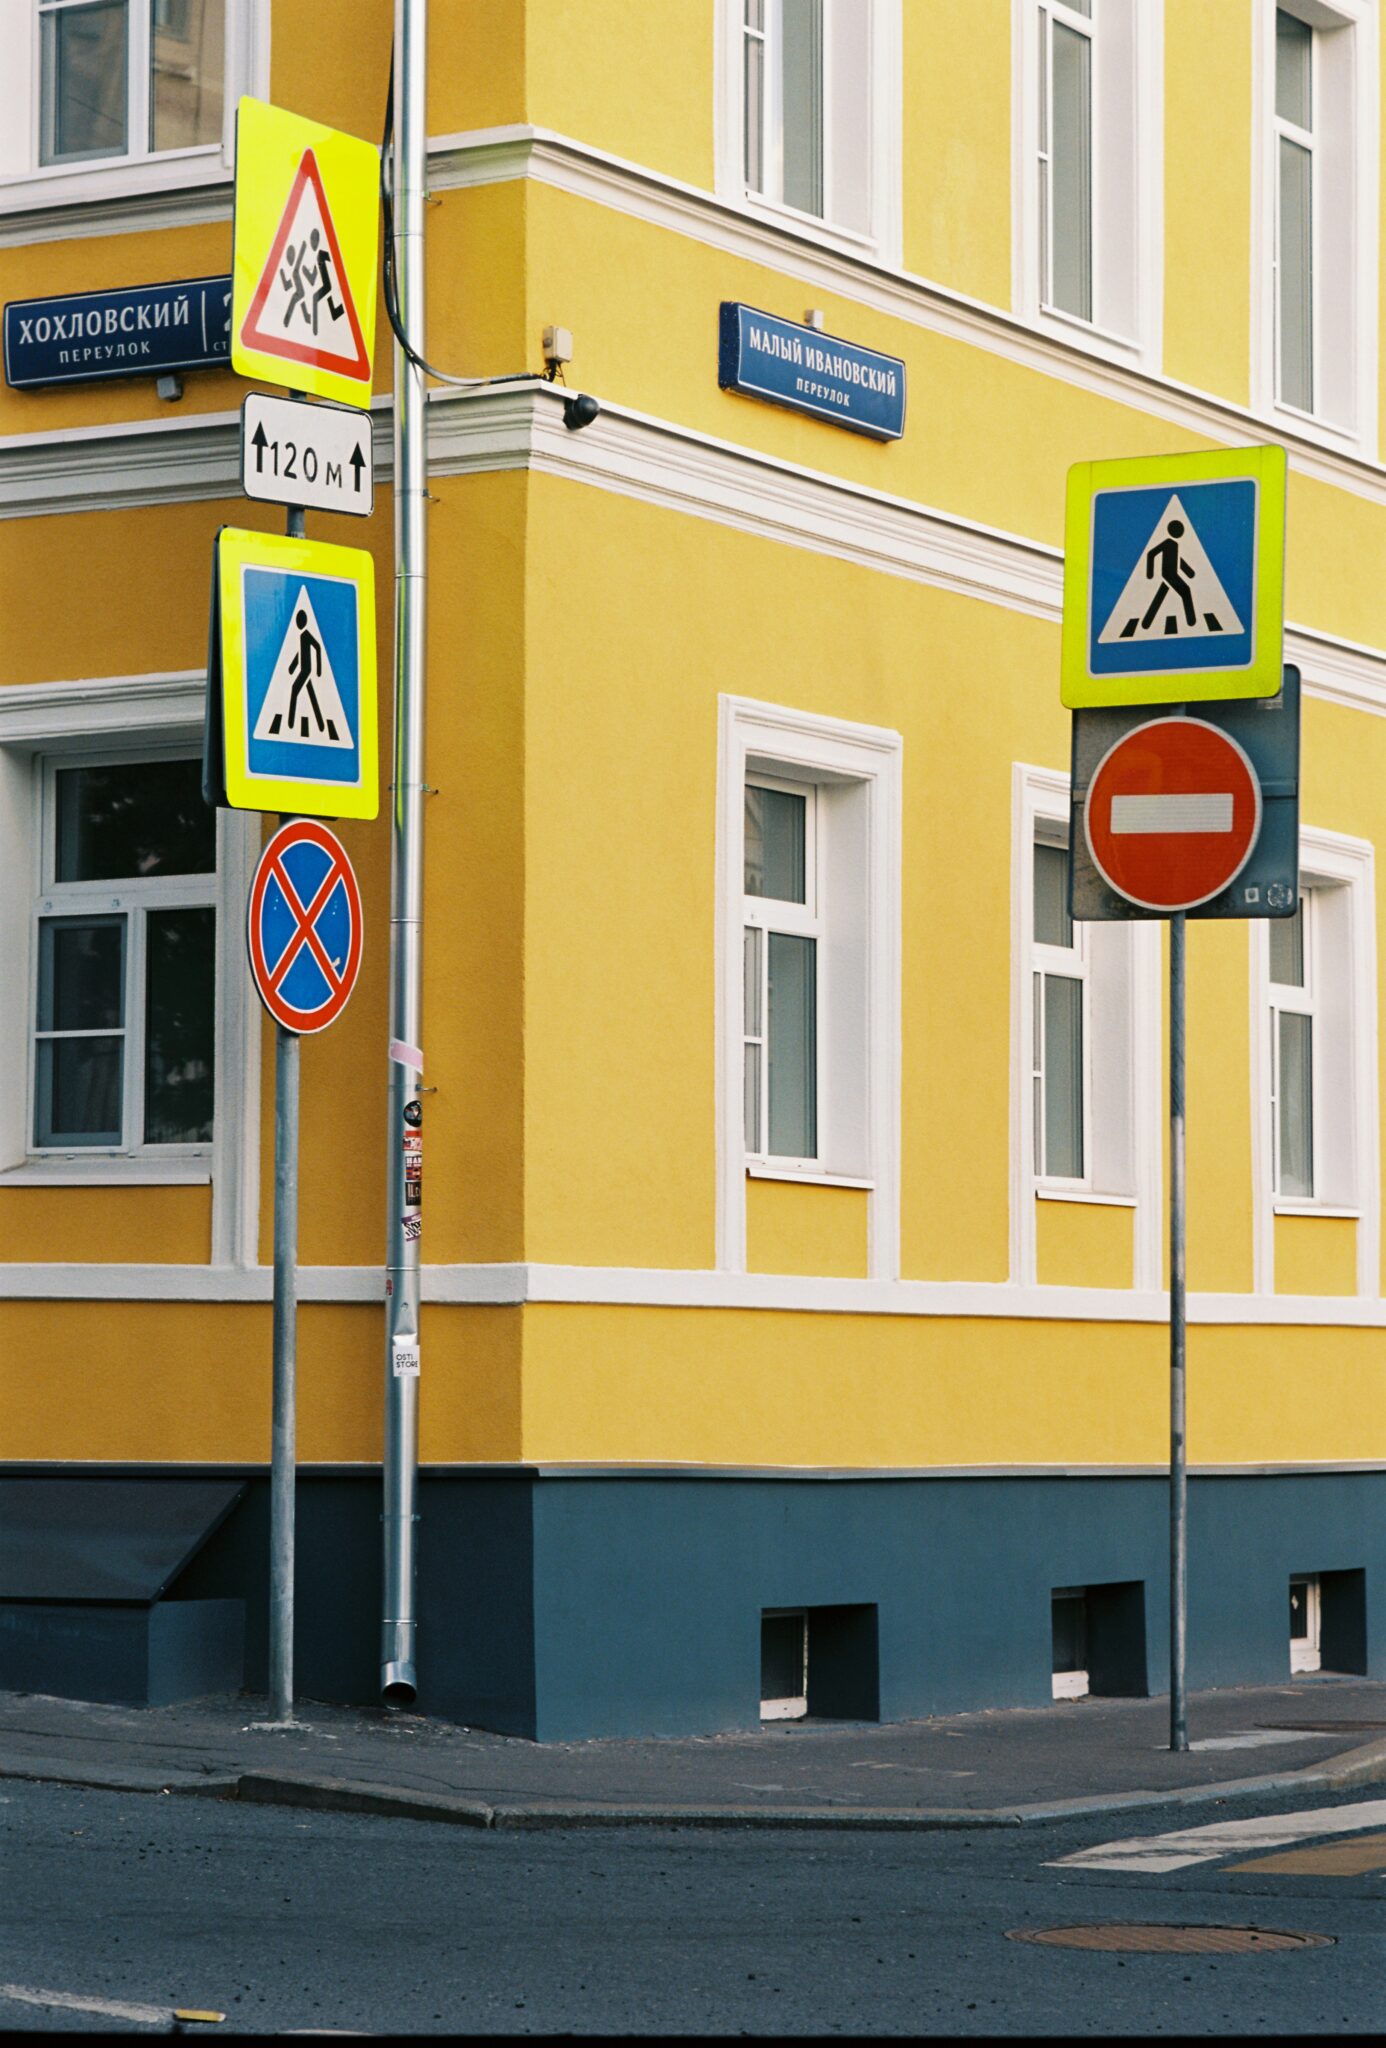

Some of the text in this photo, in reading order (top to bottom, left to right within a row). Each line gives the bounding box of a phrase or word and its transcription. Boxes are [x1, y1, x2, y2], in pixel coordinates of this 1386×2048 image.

[19, 294, 189, 345] ХОХЛОВСКИЙ
[59, 341, 150, 364] ПЕРЕУЛОК
[750, 326, 896, 397] МАЛЫЙ ИВАНОВСКИЙ
[796, 377, 850, 407] ПЕРЕУЛОК
[270, 441, 318, 483] 120
[396, 1353, 414, 1361] OSTI
[396, 1360, 418, 1368] STORE
